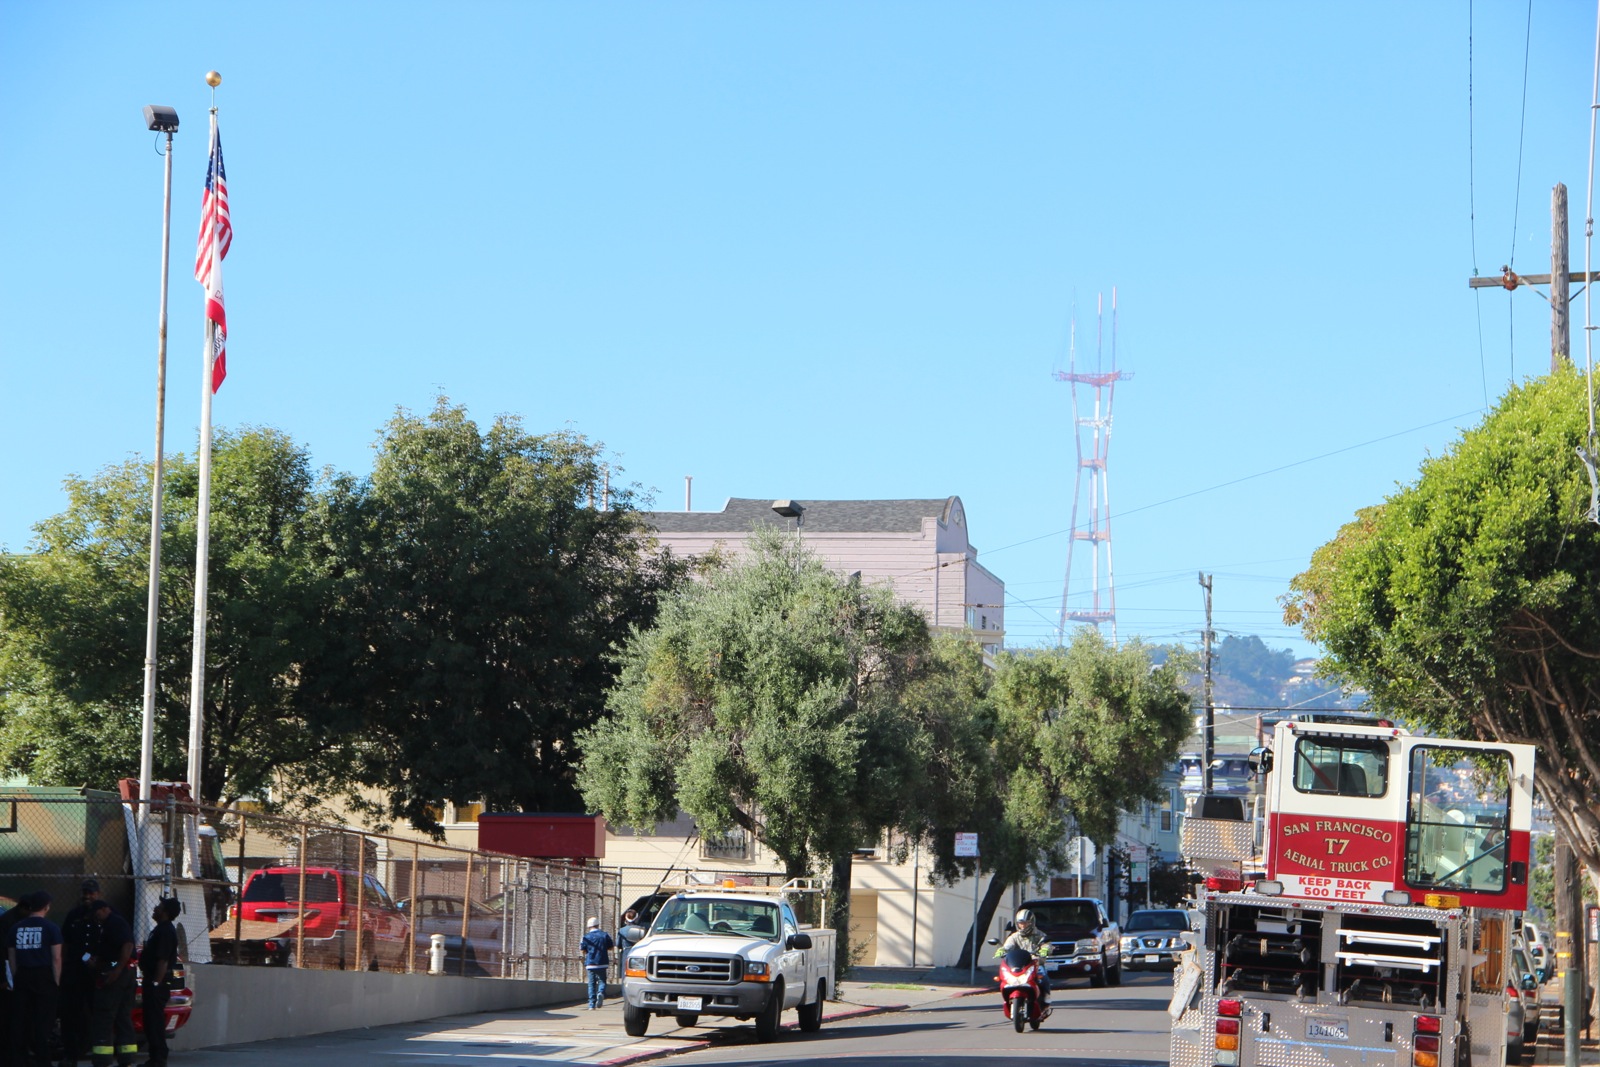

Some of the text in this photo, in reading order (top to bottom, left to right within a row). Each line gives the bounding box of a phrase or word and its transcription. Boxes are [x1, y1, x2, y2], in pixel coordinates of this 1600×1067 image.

[1283, 821, 1392, 843] SAN FRANCISCO
[1324, 838, 1350, 855] T7
[1283, 848, 1392, 873] AERIAL TRUCK CO.
[1298, 877, 1371, 890] KEEP BACK
[1304, 887, 1366, 899] 500 FEET
[16, 931, 42, 945] SFFD
[1308, 1025, 1345, 1038] 1341065
